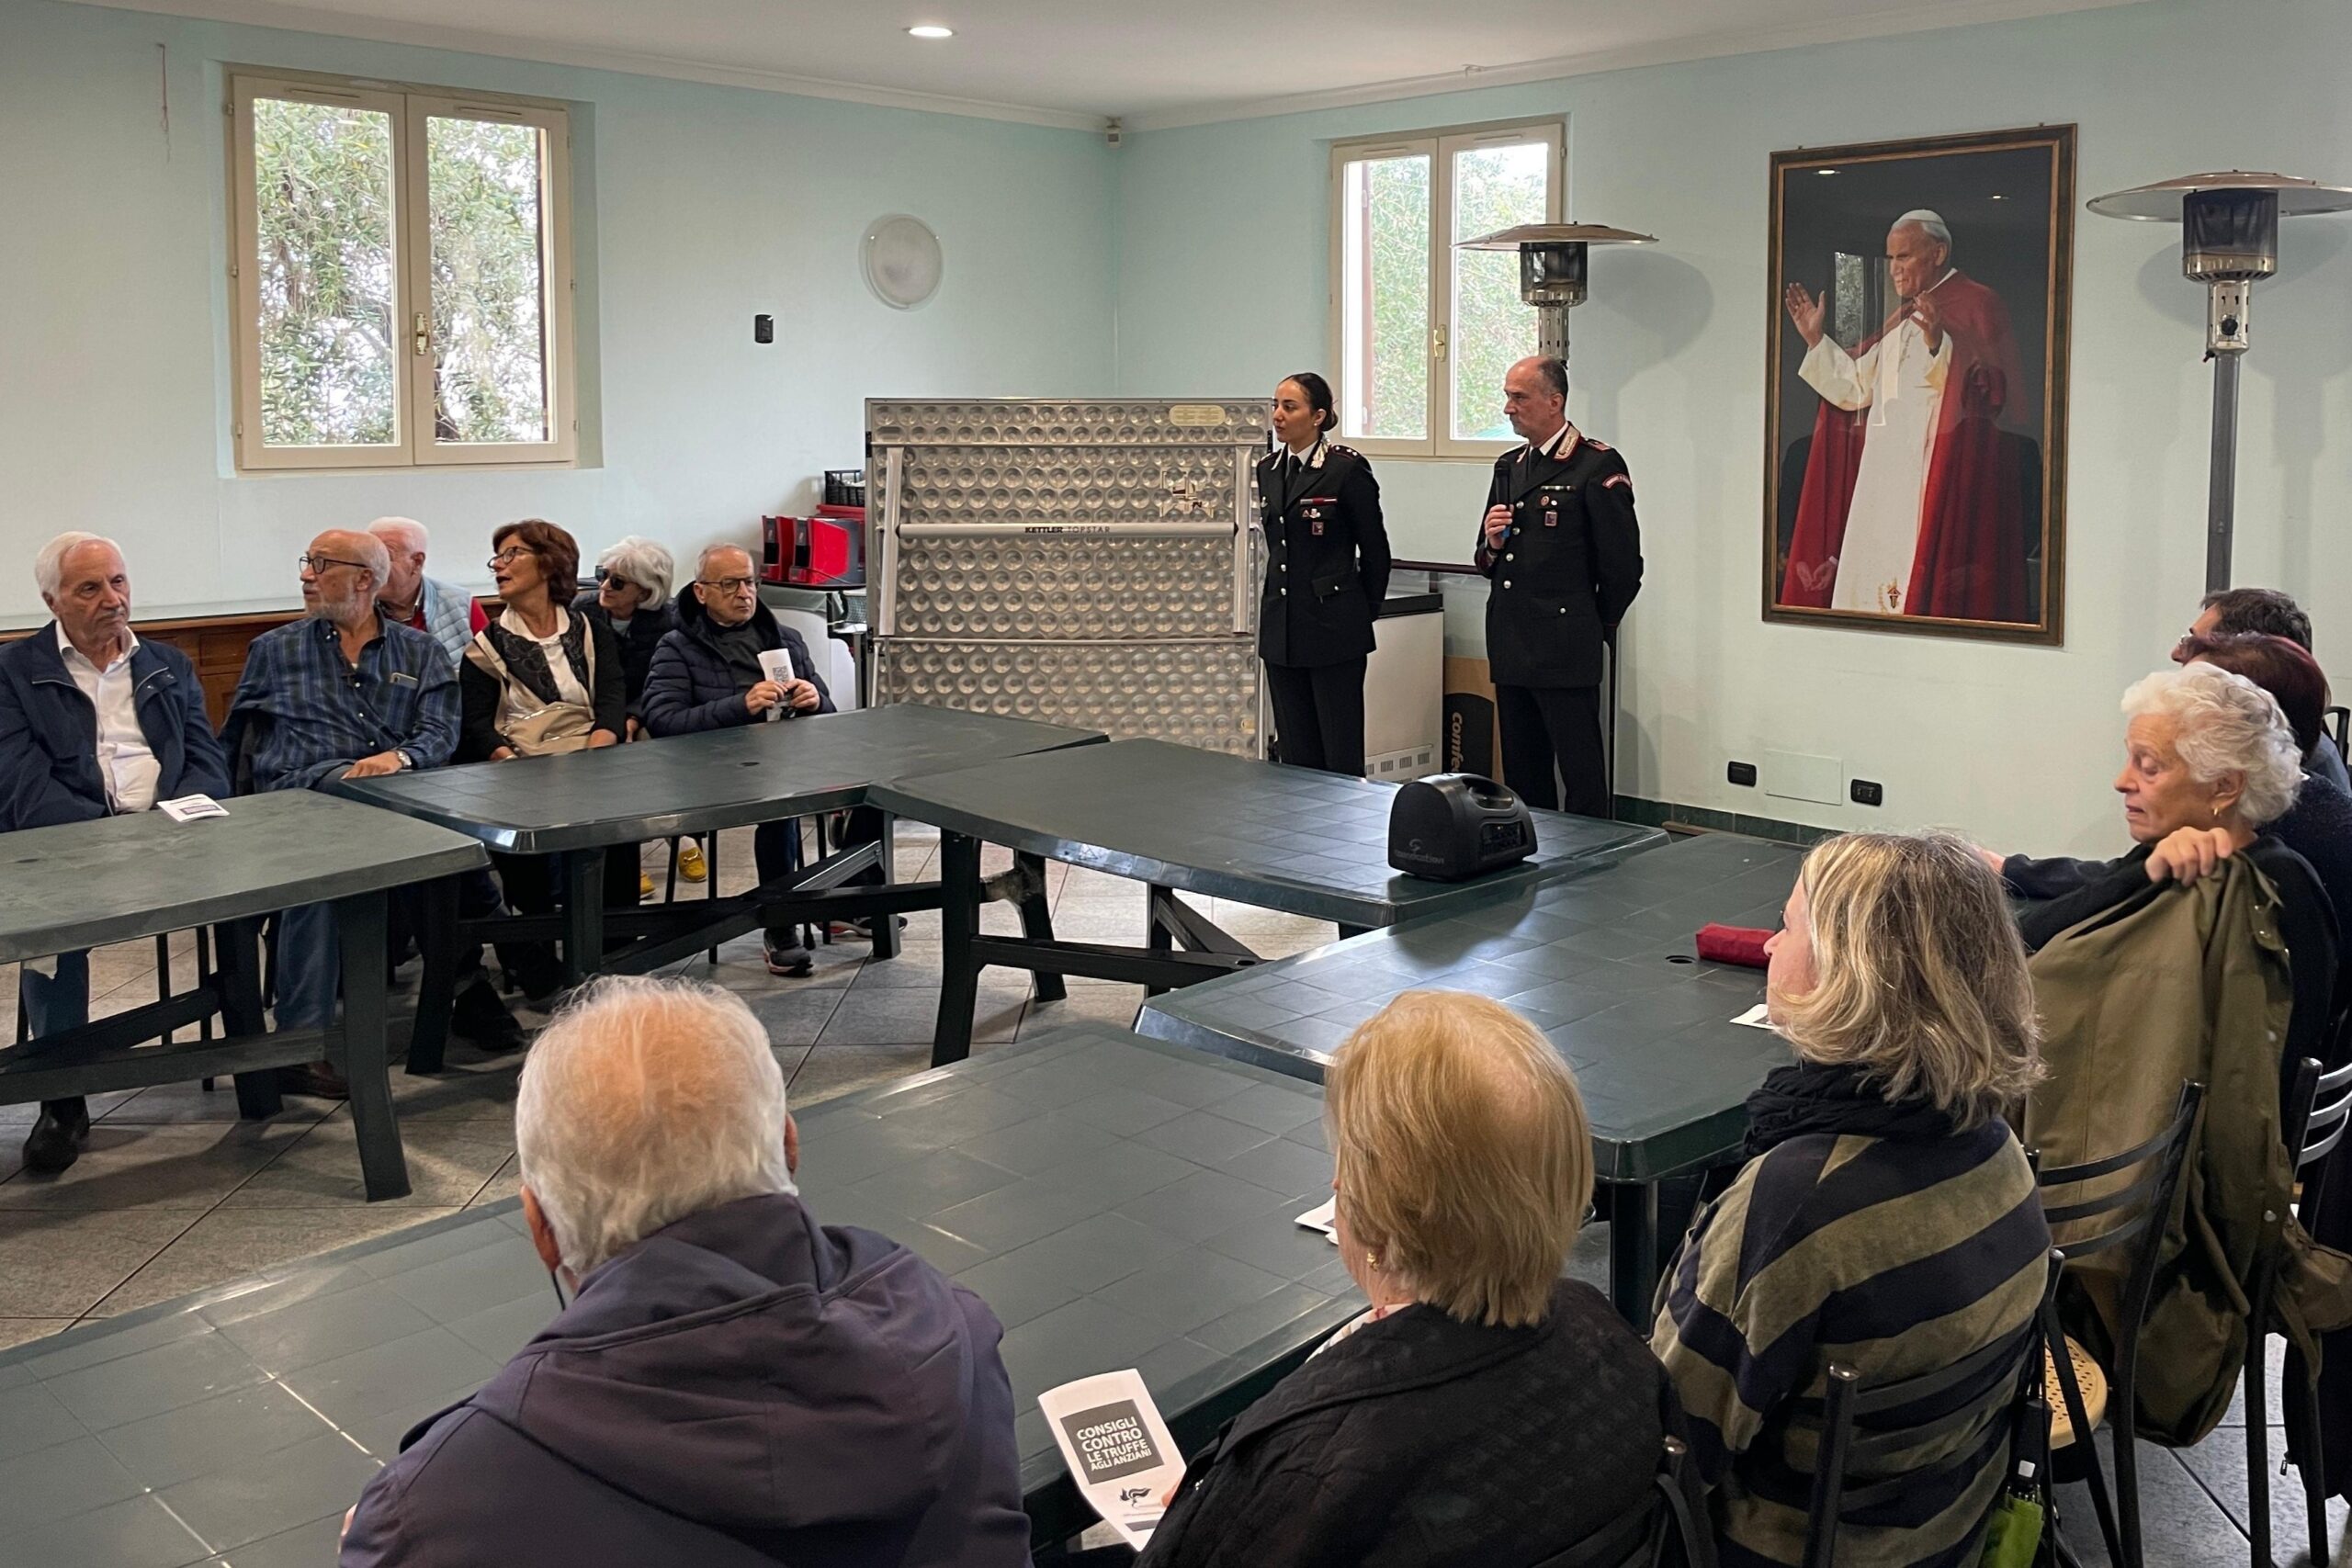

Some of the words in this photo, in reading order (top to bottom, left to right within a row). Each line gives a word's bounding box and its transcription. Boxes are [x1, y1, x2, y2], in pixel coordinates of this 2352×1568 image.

[1068, 525, 1110, 534] TOPSTAR
[1077, 1416, 1137, 1440] CONSIGLI
[1081, 1427, 1142, 1451] CONTRO
[1086, 1450, 1102, 1463] LE
[1102, 1438, 1148, 1459] TRUFFE
[1091, 1459, 1113, 1472] AGLI
[1114, 1448, 1152, 1466] ANZIANI
